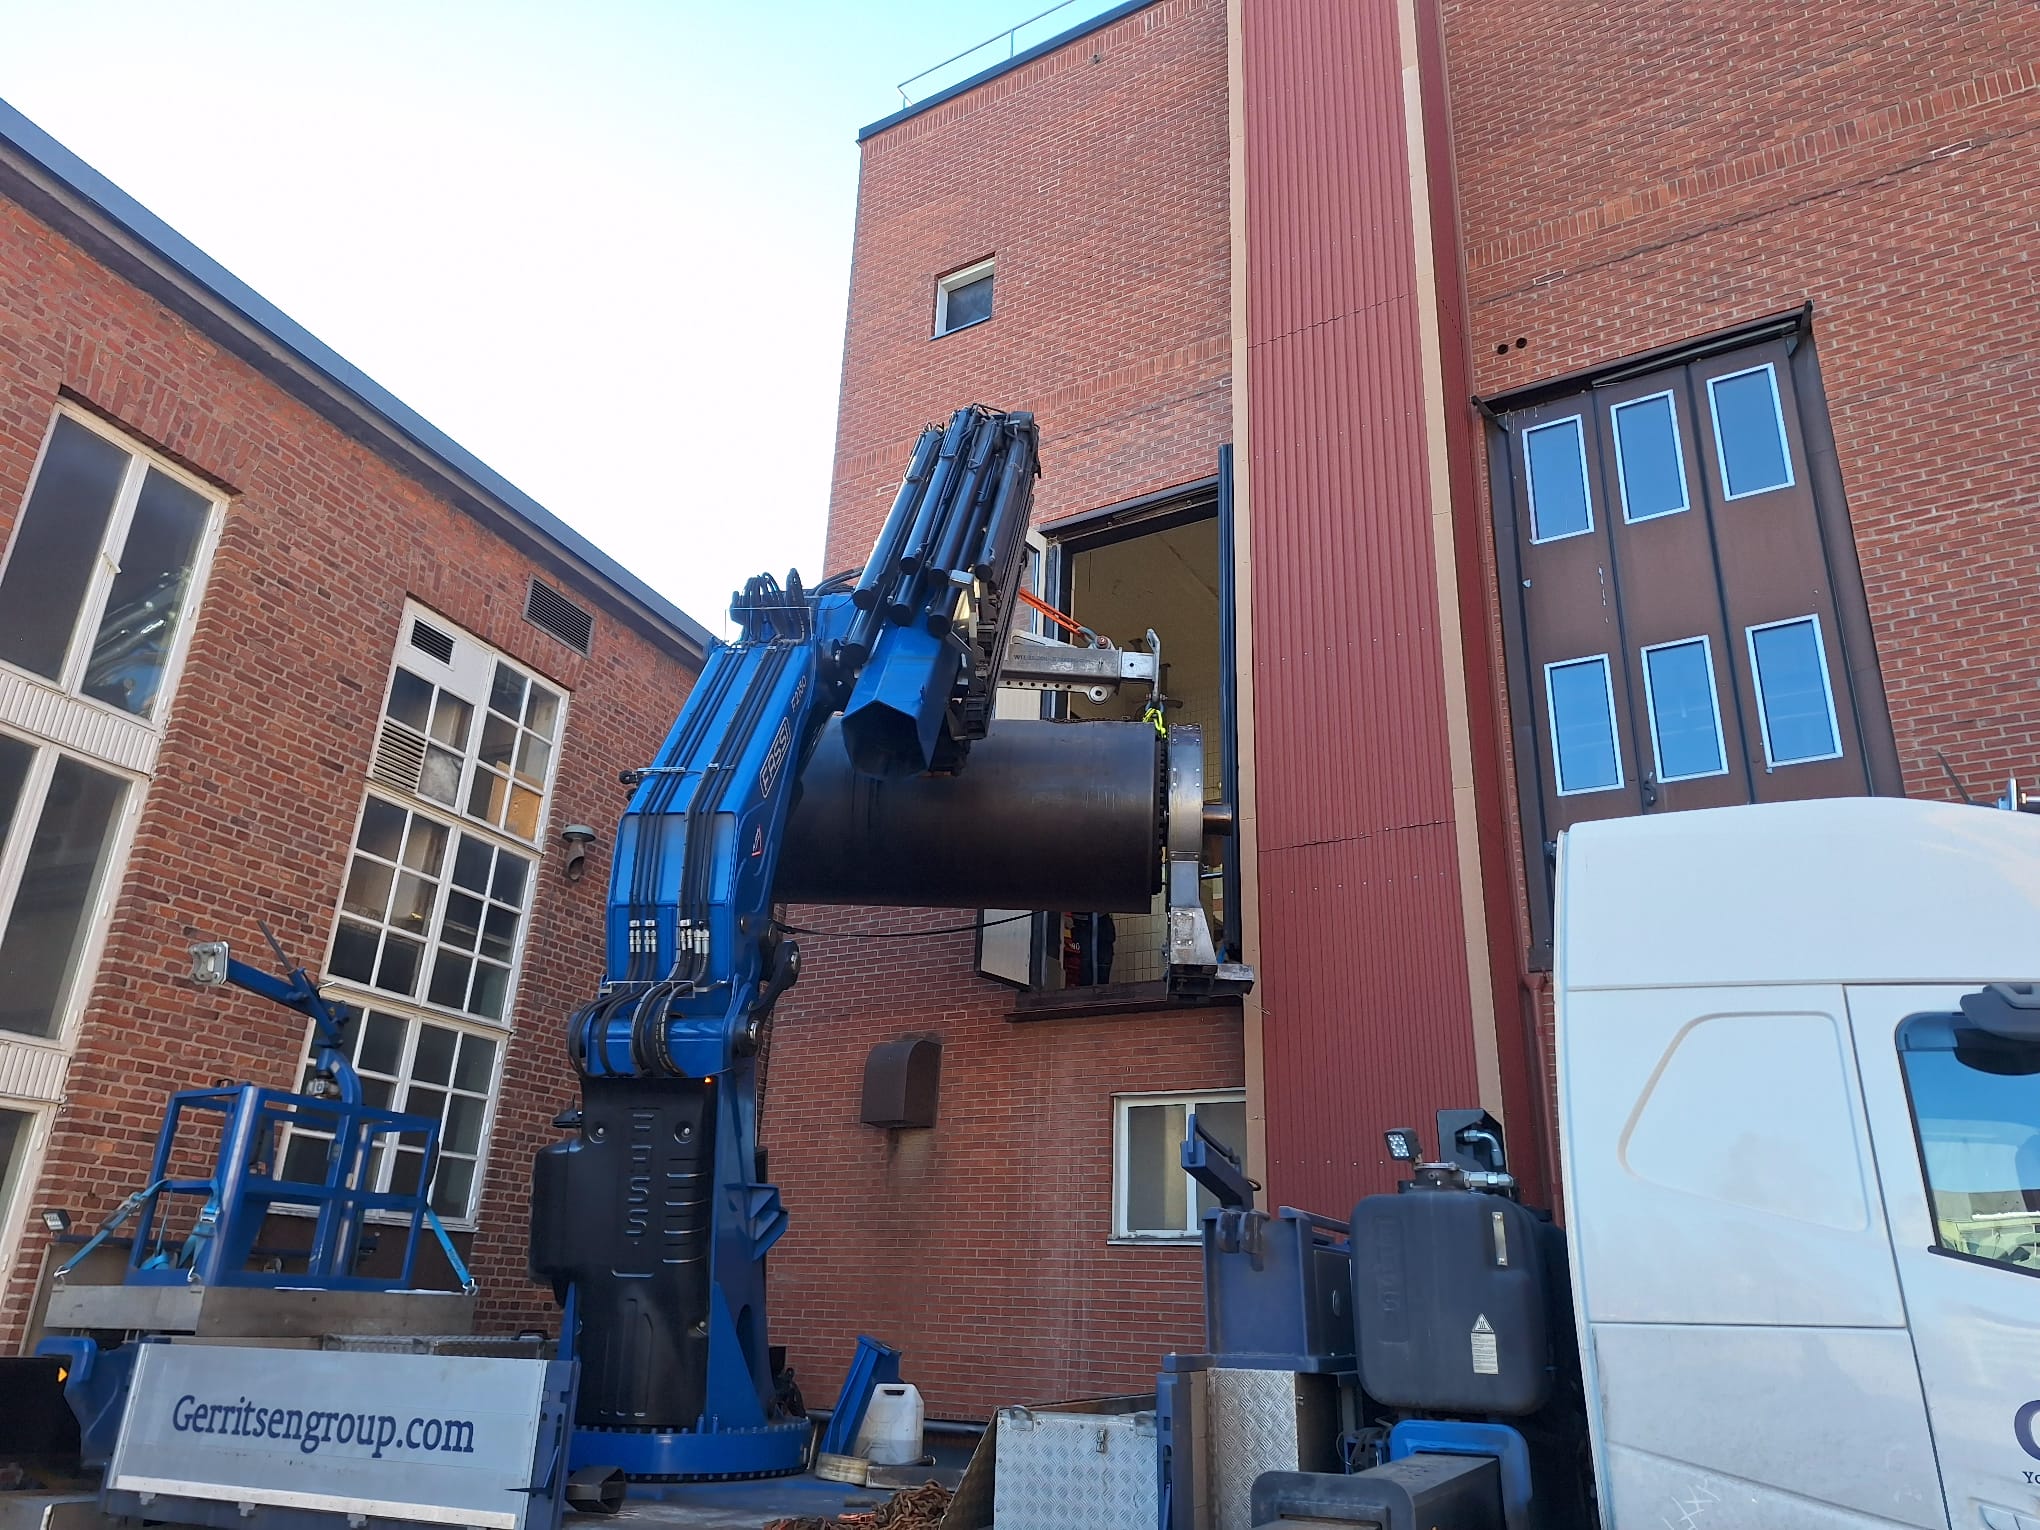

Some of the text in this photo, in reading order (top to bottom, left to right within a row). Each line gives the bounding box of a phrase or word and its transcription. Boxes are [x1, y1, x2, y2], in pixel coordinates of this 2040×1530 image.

[761, 721, 790, 792] FASSI
[625, 1112, 655, 1262] FASS
[172, 1394, 474, 1459] Gerritsengroup.com
